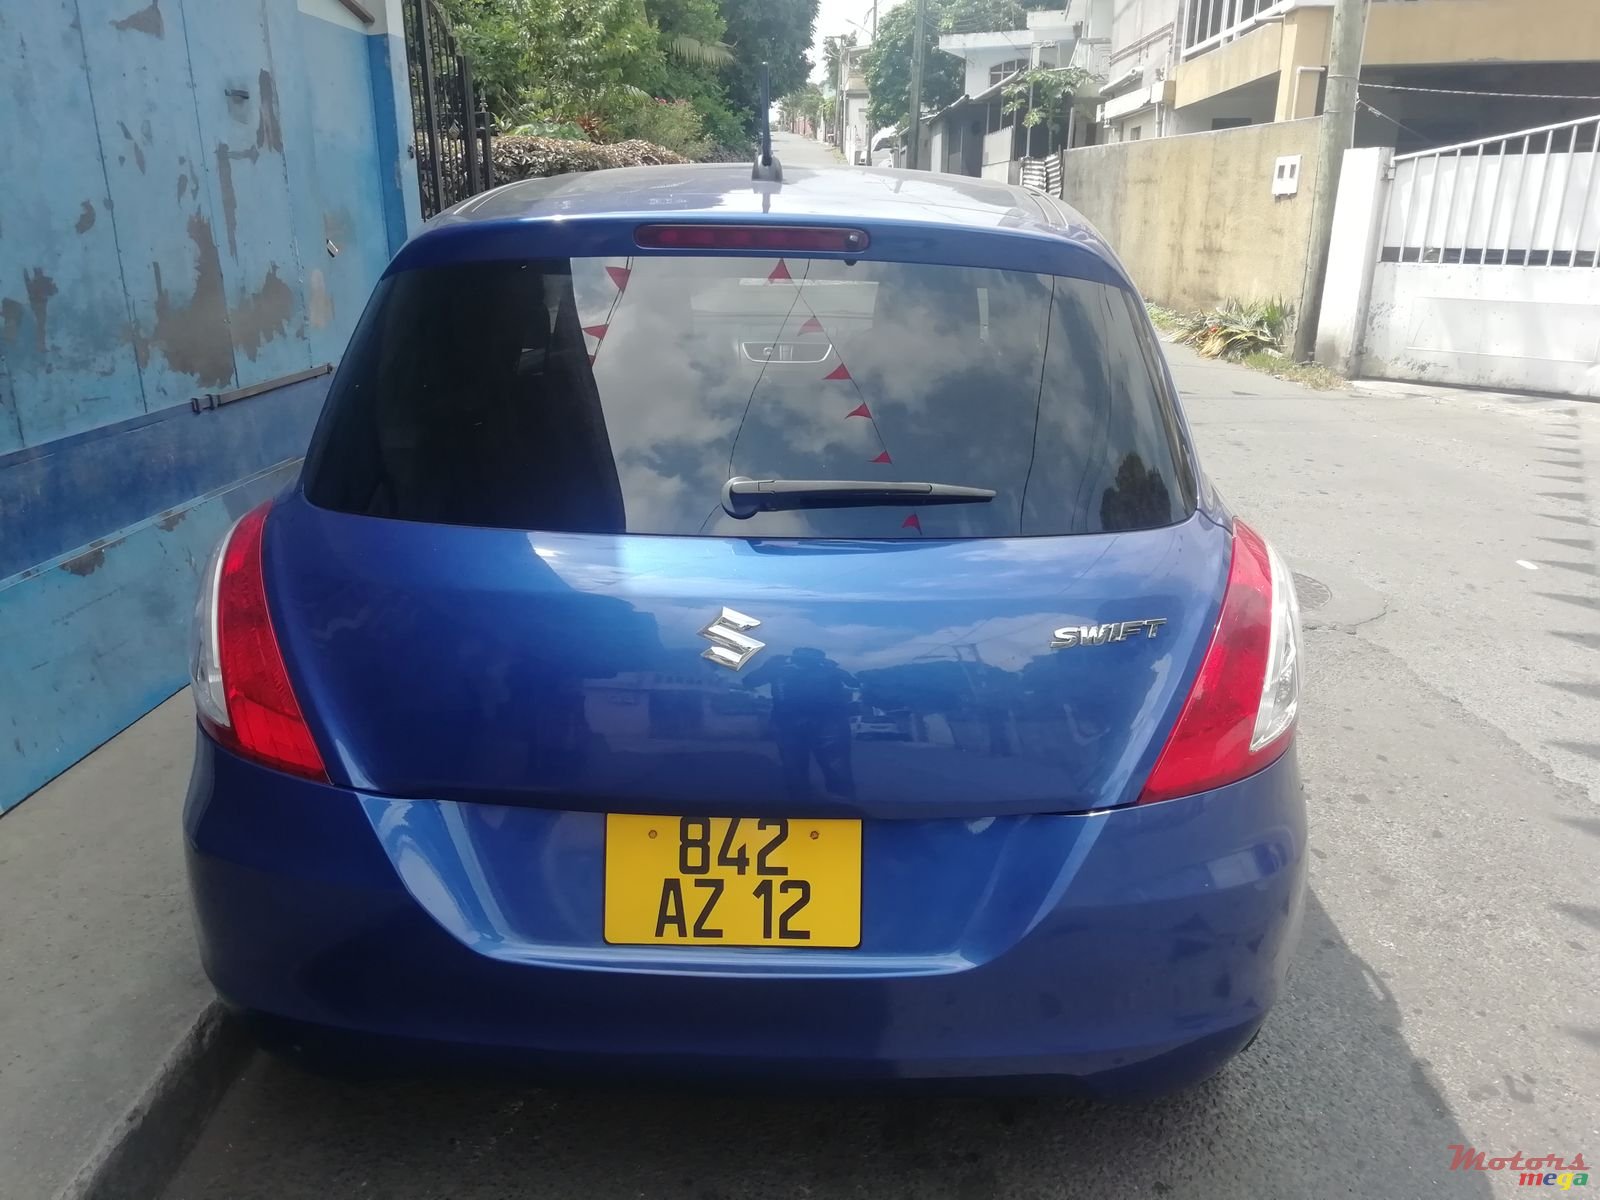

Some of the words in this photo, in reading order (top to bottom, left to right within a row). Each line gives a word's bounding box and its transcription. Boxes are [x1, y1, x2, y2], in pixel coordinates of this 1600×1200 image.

[1050, 618, 1167, 648] SWIFT
[678, 816, 789, 876] 842
[654, 878, 725, 938] AZ
[752, 879, 811, 940] 12
